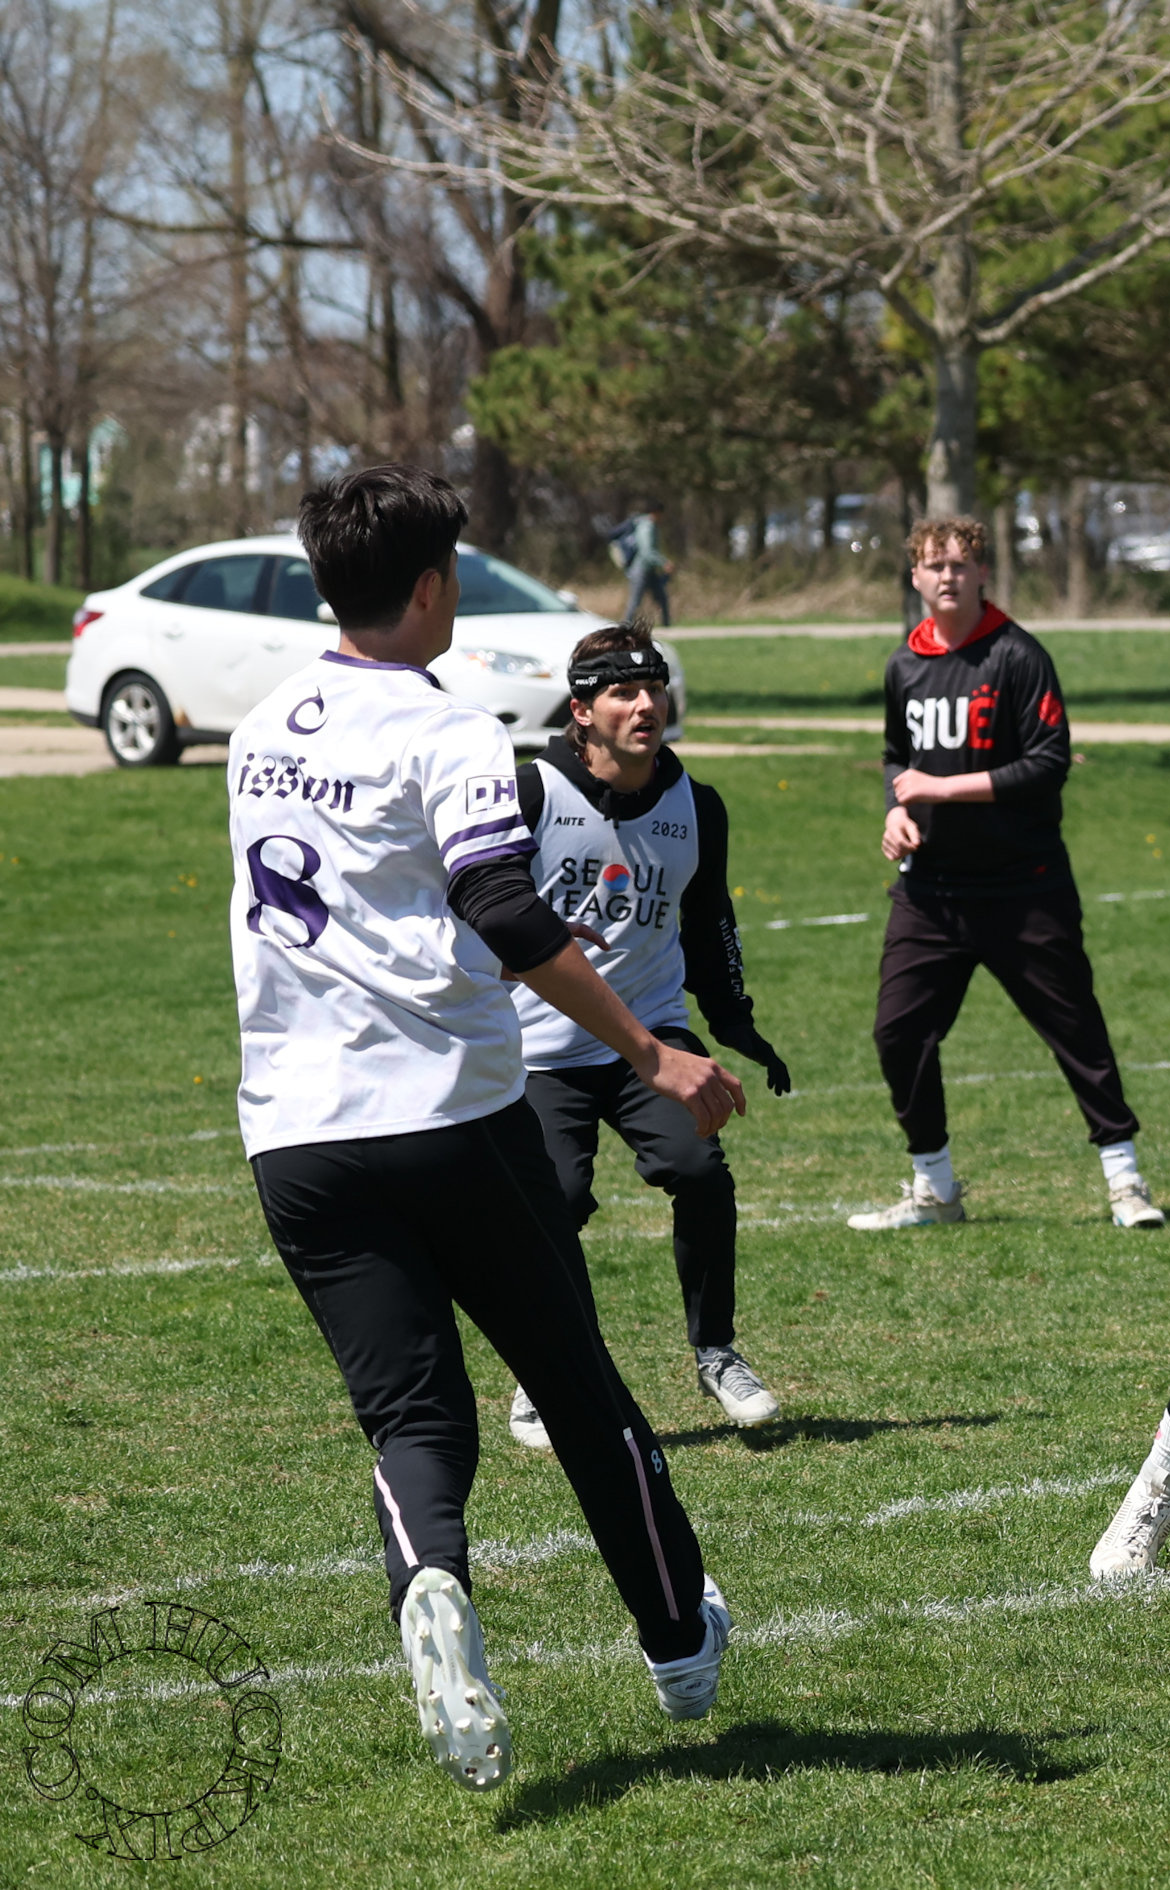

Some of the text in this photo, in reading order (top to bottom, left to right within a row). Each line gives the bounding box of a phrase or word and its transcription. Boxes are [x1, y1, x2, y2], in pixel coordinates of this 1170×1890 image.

[906, 693, 997, 751] SIUE
[652, 820, 687, 840] 2023
[246, 835, 329, 949] 8
[548, 889, 670, 929] LEAGUE
[651, 1449, 663, 1474] 8
